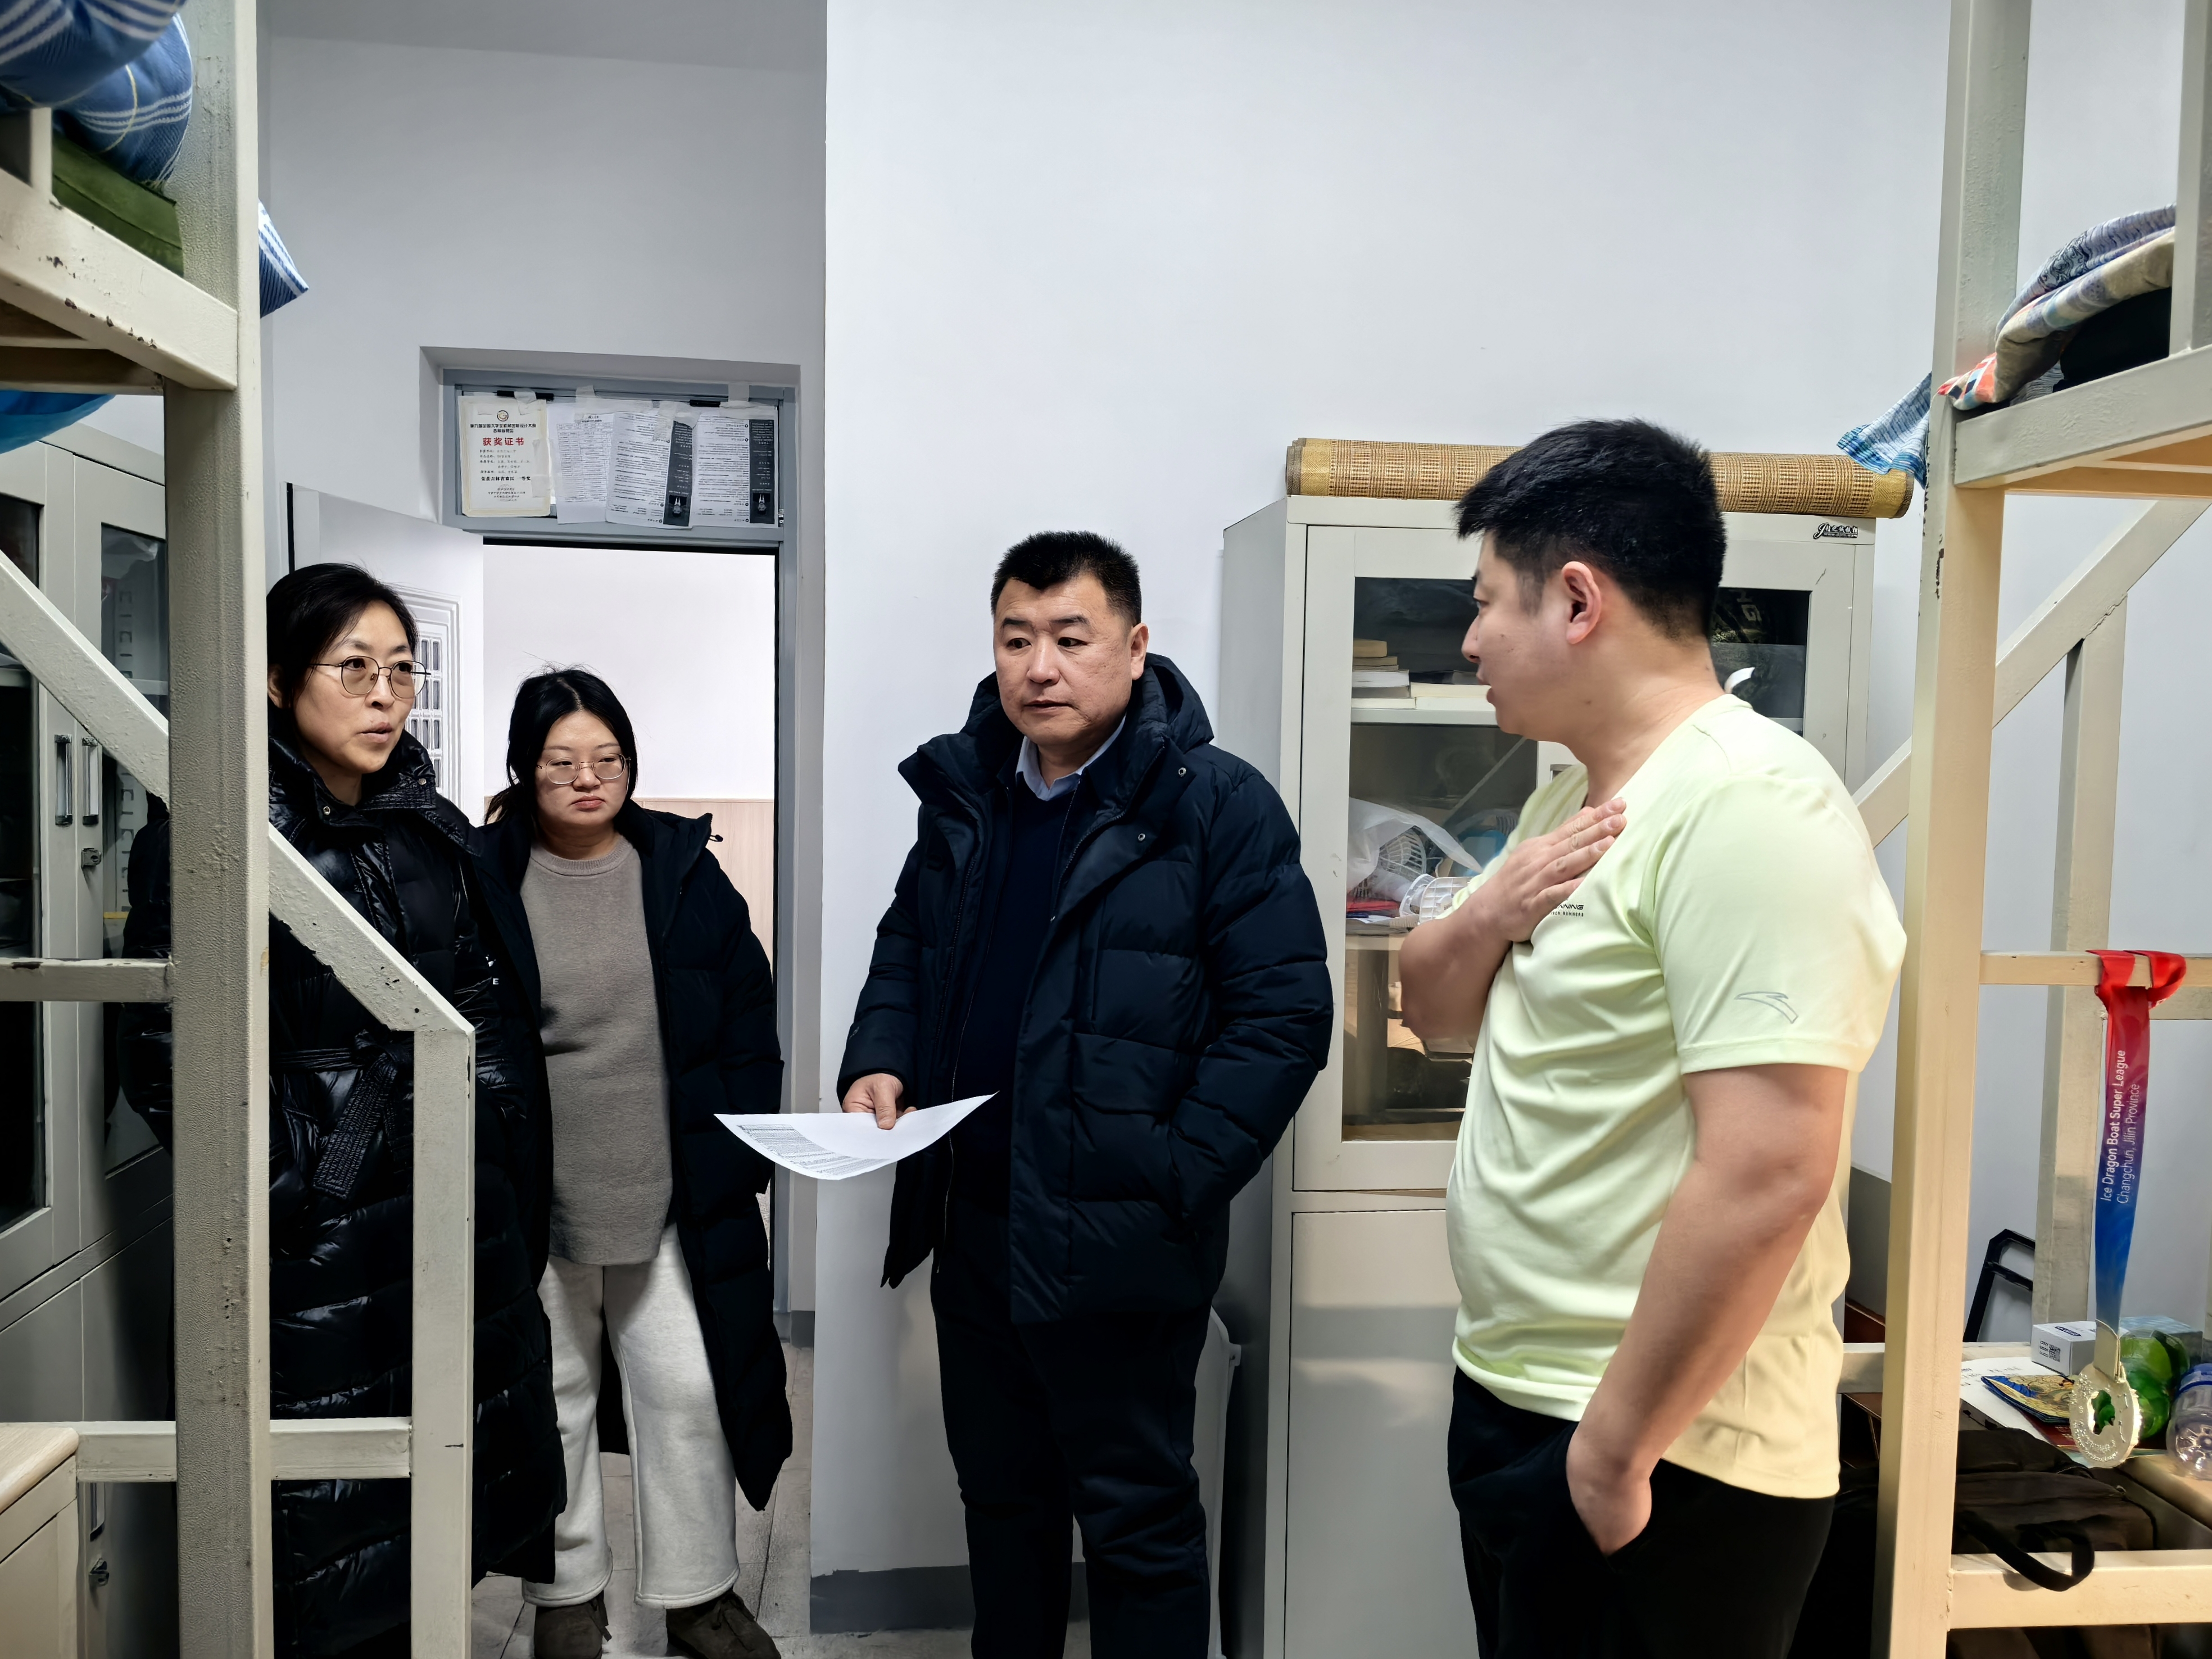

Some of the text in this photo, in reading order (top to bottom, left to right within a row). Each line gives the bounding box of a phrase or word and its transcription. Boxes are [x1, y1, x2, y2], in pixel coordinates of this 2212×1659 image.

[482, 437, 524, 446] 获奖证书
[2100, 1050, 2129, 1202] Ice Dragon Boat Super League
[2116, 1084, 2140, 1204] Changchun, Jilin Province
